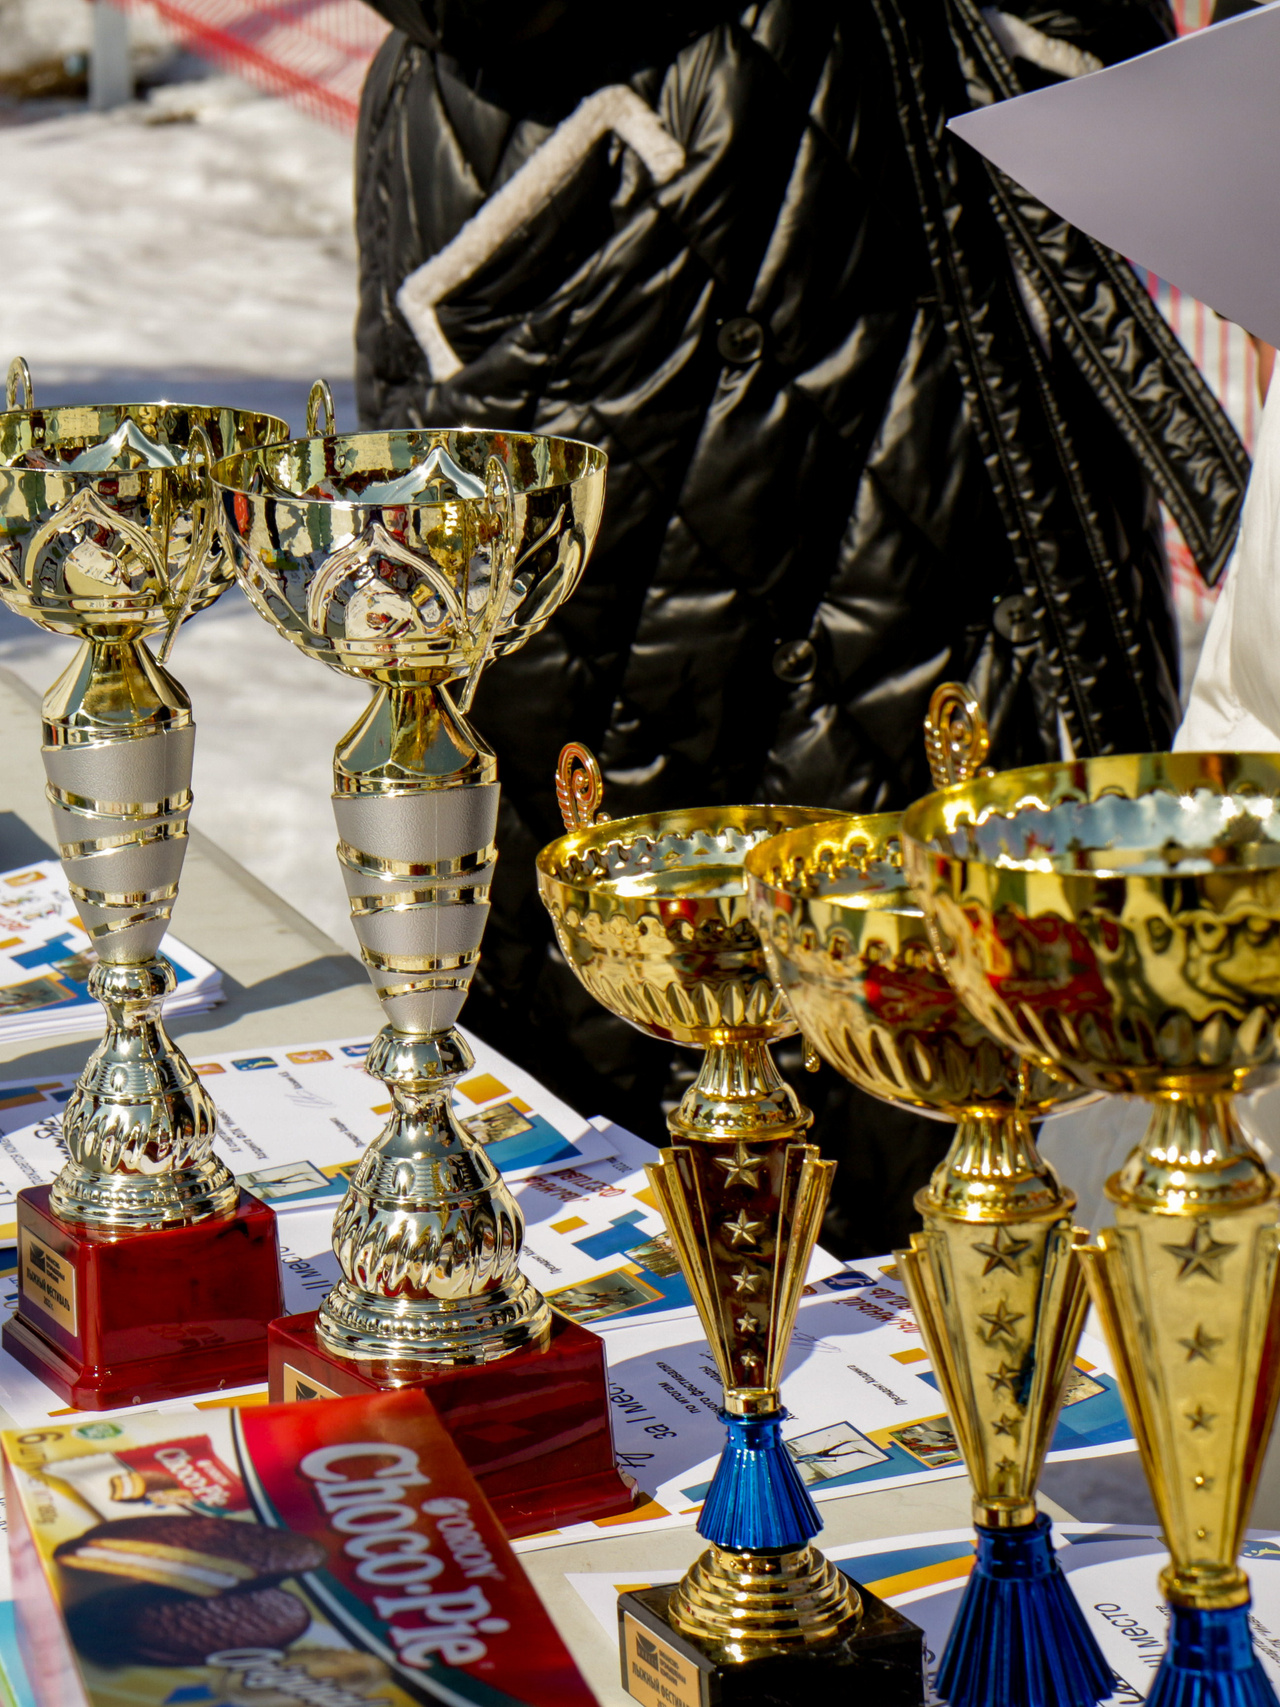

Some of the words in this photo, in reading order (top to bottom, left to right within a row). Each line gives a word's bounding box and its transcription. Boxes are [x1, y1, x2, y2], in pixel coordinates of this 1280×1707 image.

[656, 1361, 705, 1397] фестиваля»
[658, 1381, 689, 1404] итогам
[609, 1383, 647, 1414] мес
[685, 1403, 701, 1414] по
[644, 1423, 677, 1440] за
[1094, 1603, 1164, 1648] место
[631, 1661, 661, 1695] ЛЫЖНЫЙ
